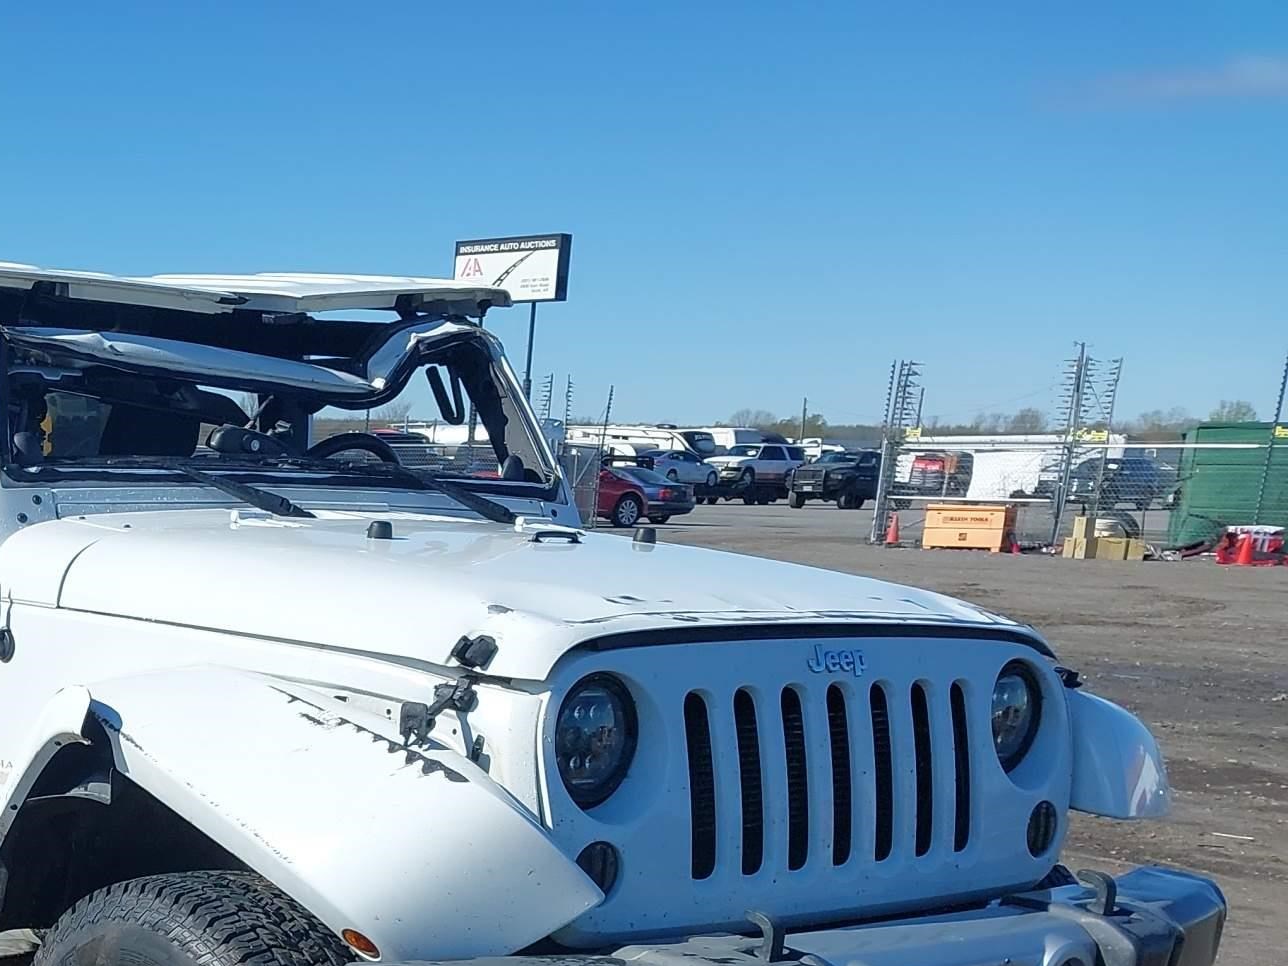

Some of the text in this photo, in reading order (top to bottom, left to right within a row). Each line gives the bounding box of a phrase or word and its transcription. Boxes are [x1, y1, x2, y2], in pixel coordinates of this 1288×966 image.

[459, 239, 557, 254] INSURANCE AUTO AUCTIONS
[807, 644, 868, 677] Jeep
